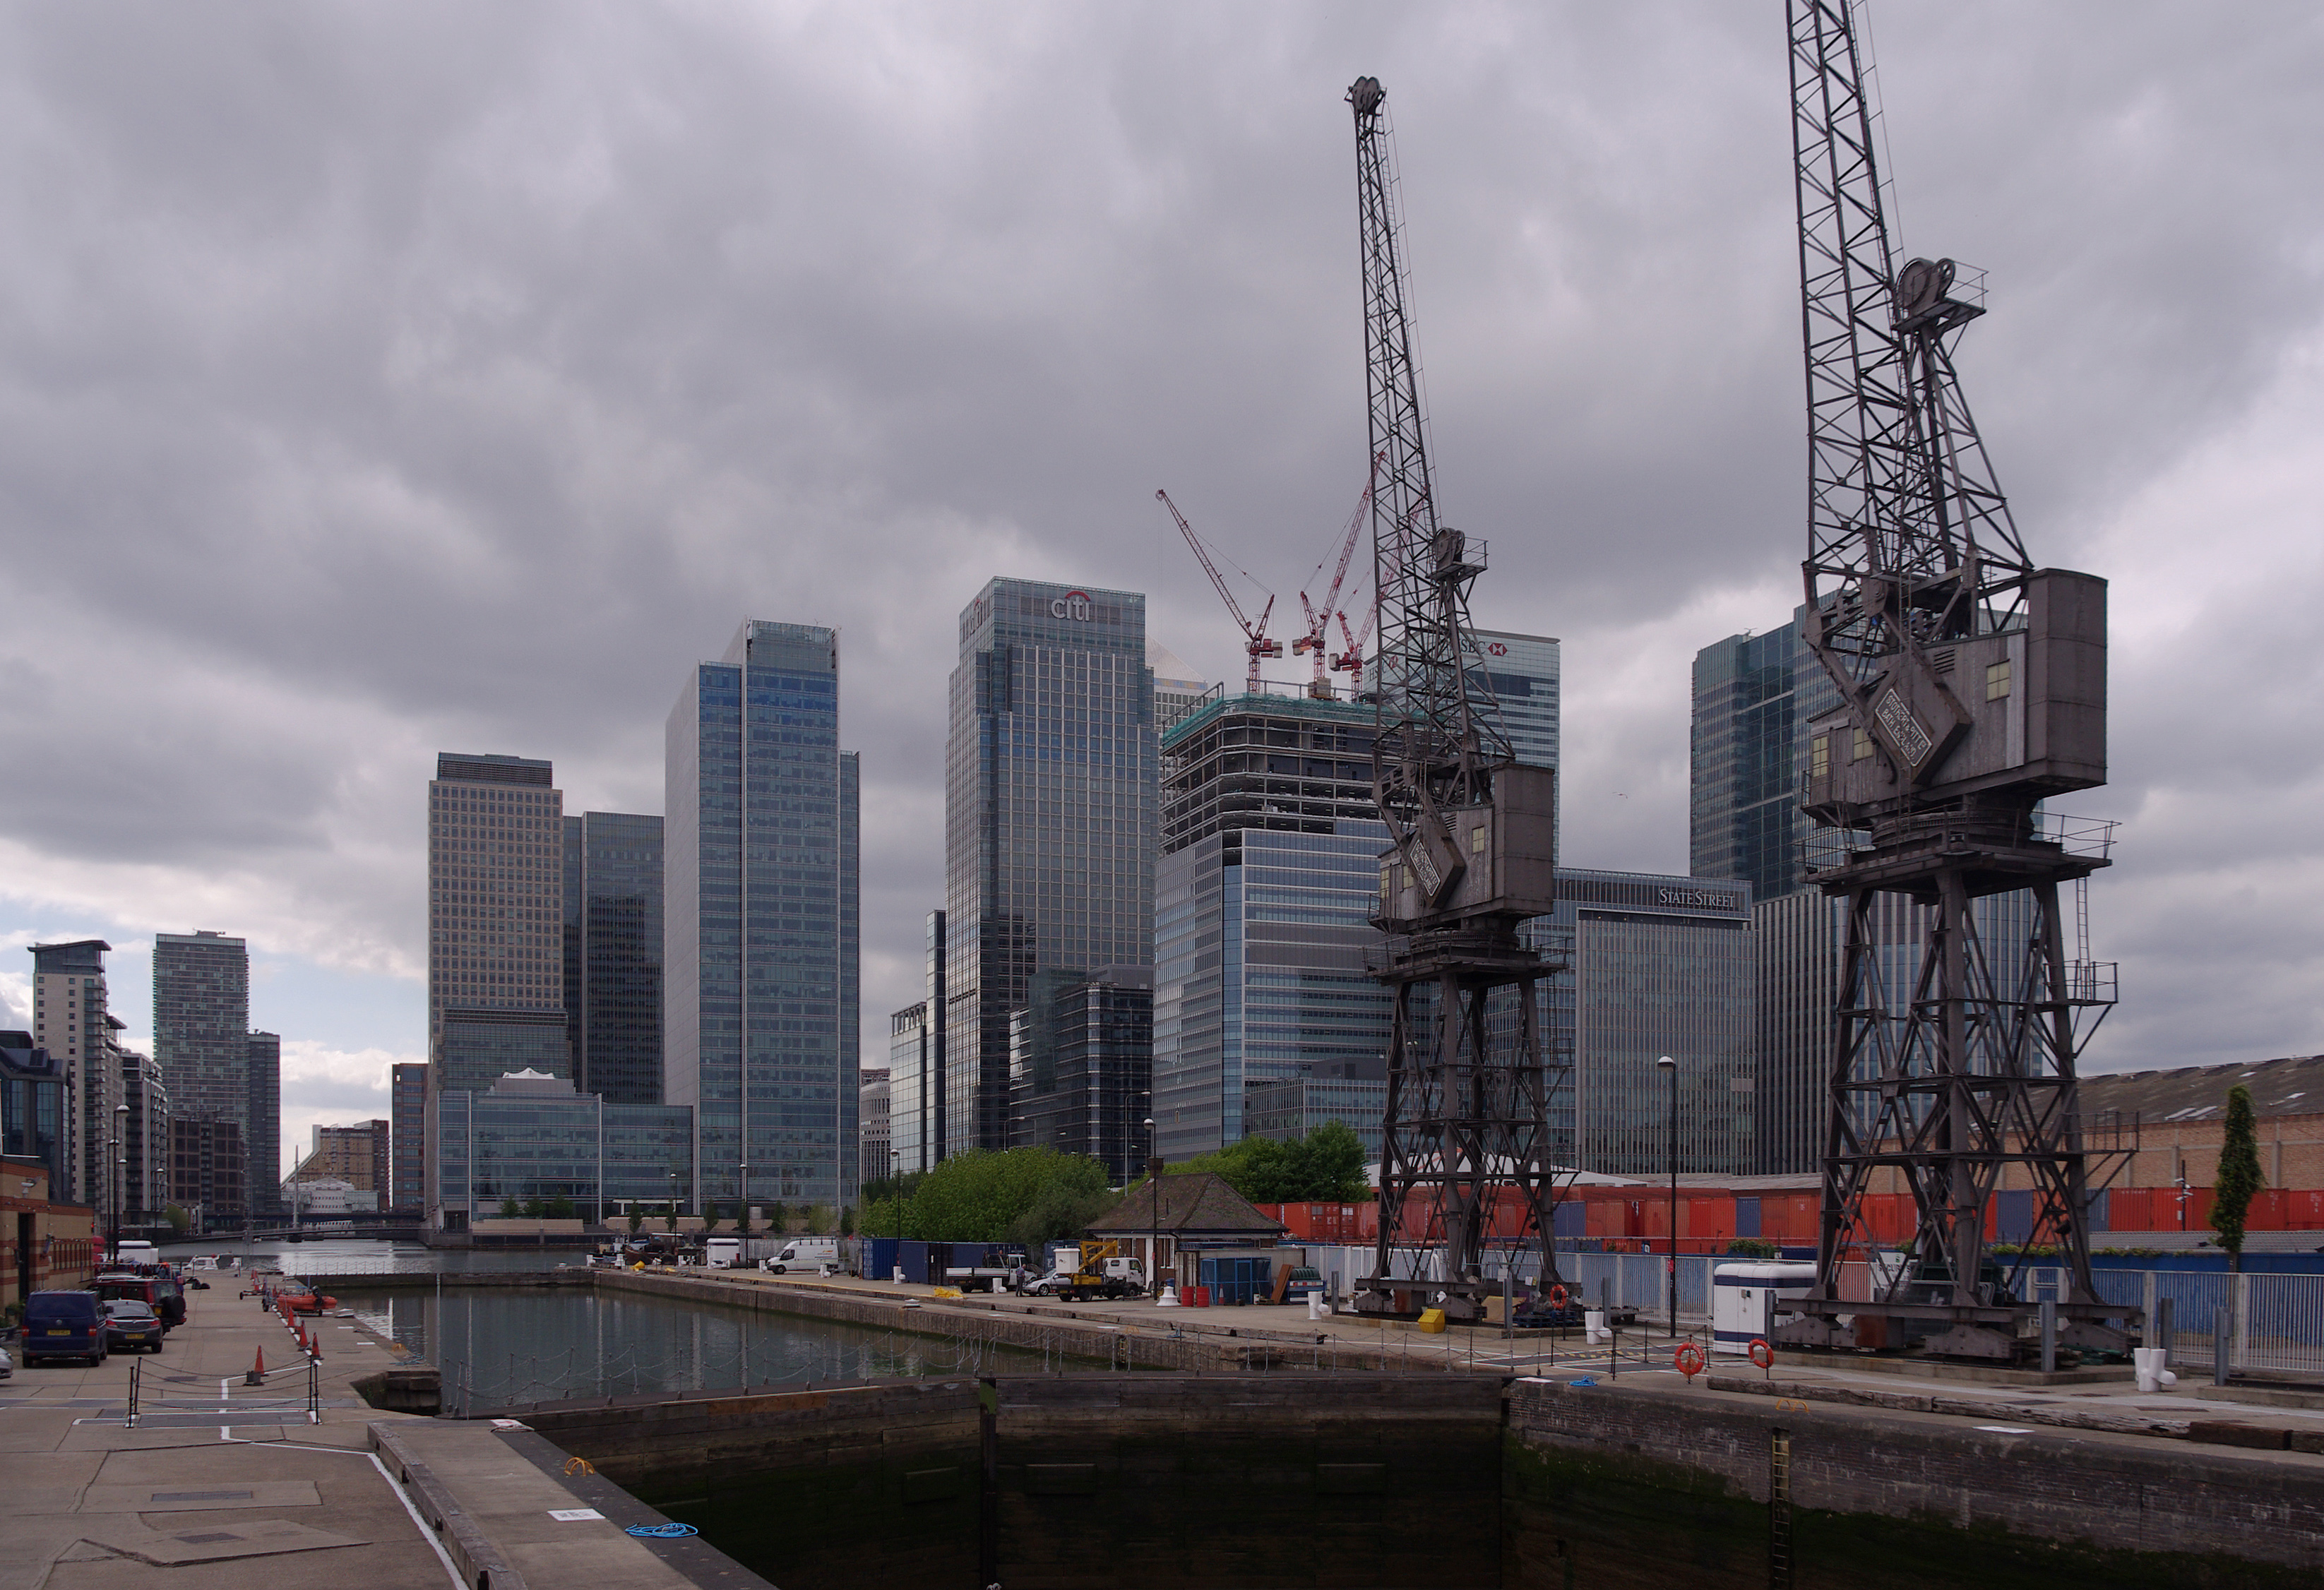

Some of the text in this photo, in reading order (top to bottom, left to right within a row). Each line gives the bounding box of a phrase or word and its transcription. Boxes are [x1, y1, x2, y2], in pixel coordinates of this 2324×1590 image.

[1051, 593, 1090, 621] citi
[1459, 638, 1486, 654] SBC
[1659, 888, 1735, 908] STATE STREET
